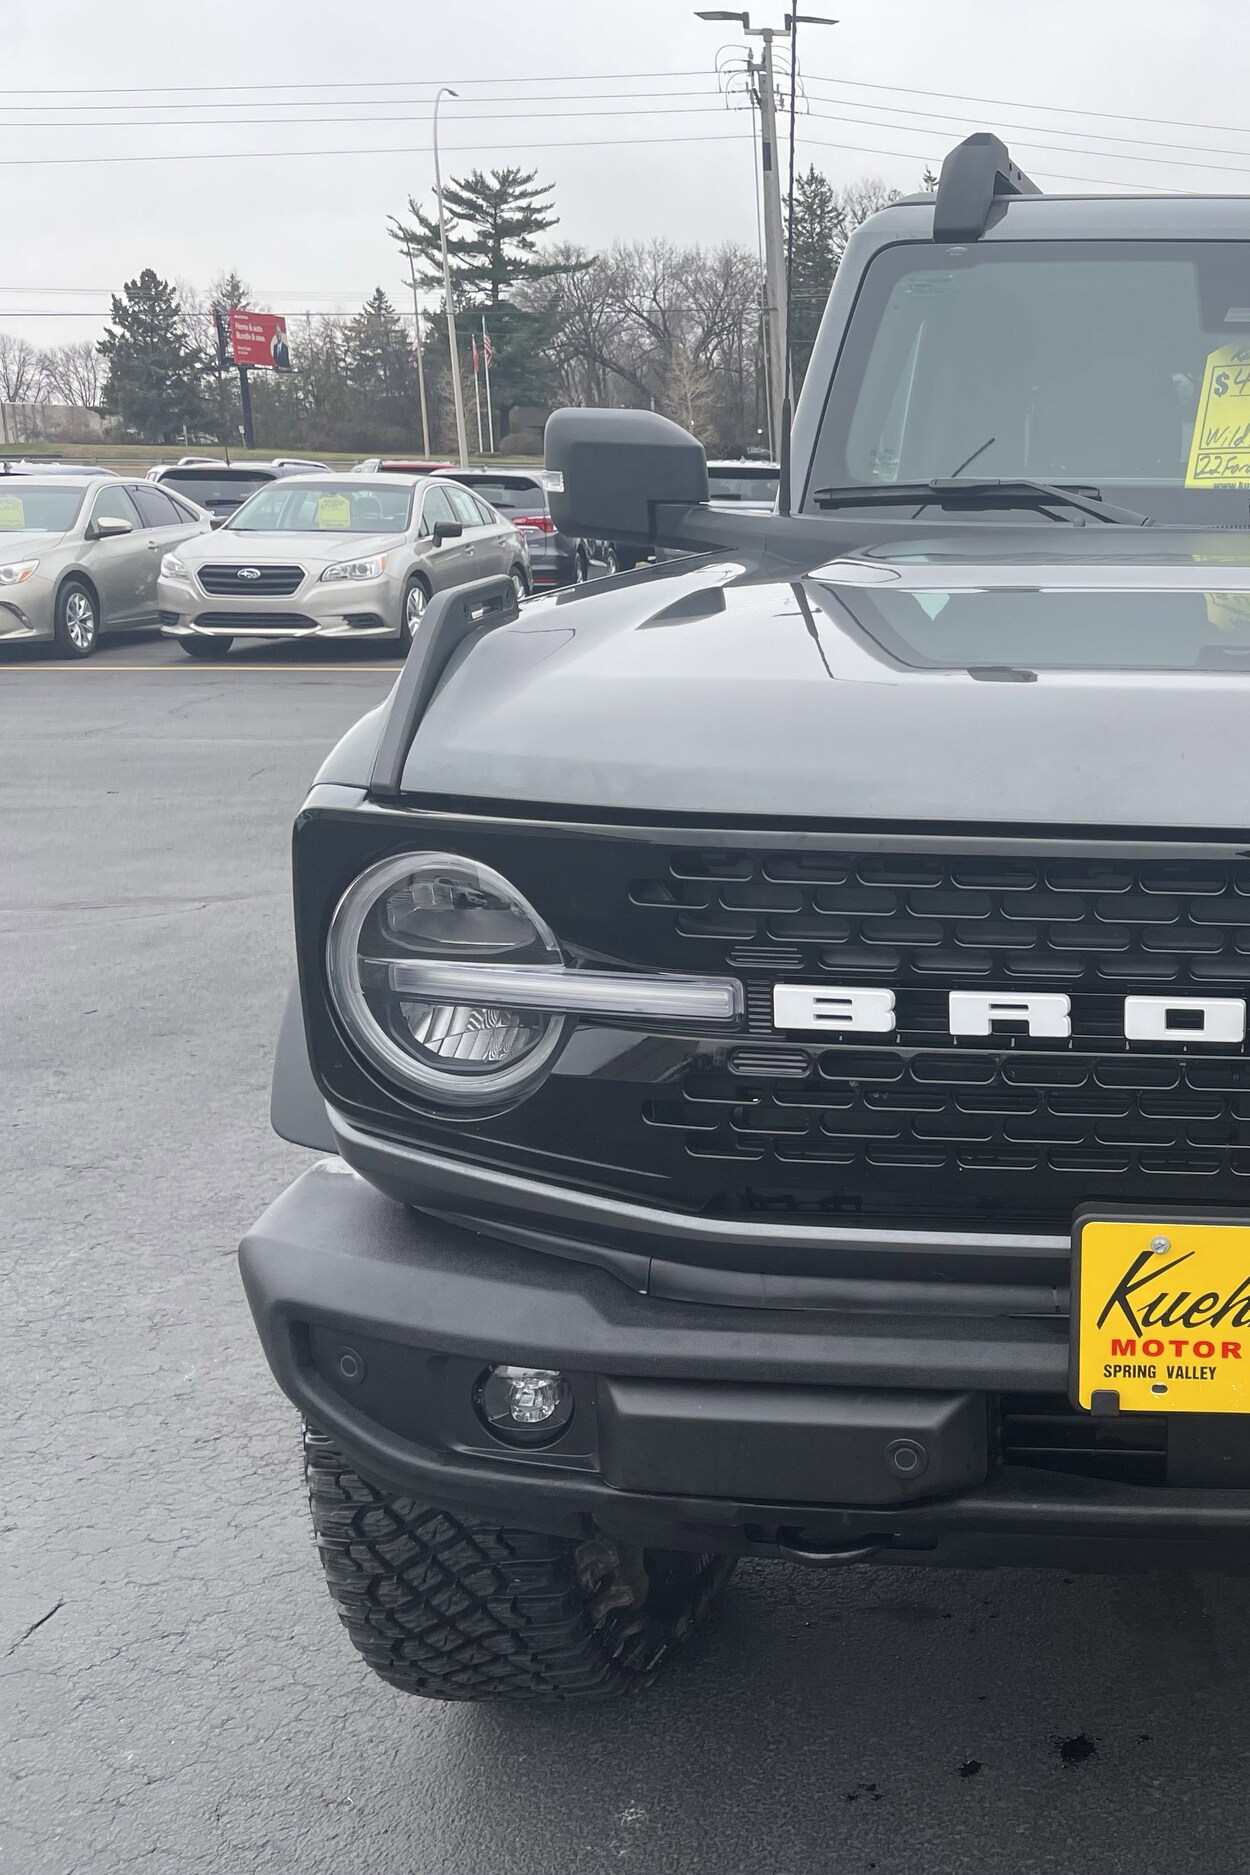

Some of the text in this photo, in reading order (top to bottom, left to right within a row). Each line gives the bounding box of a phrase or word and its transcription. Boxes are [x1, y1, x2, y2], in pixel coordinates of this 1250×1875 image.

[1111, 1339, 1243, 1360] MOTOR
[1103, 1364, 1157, 1379] SPRING
[1166, 1366, 1217, 1380] VALLEY
